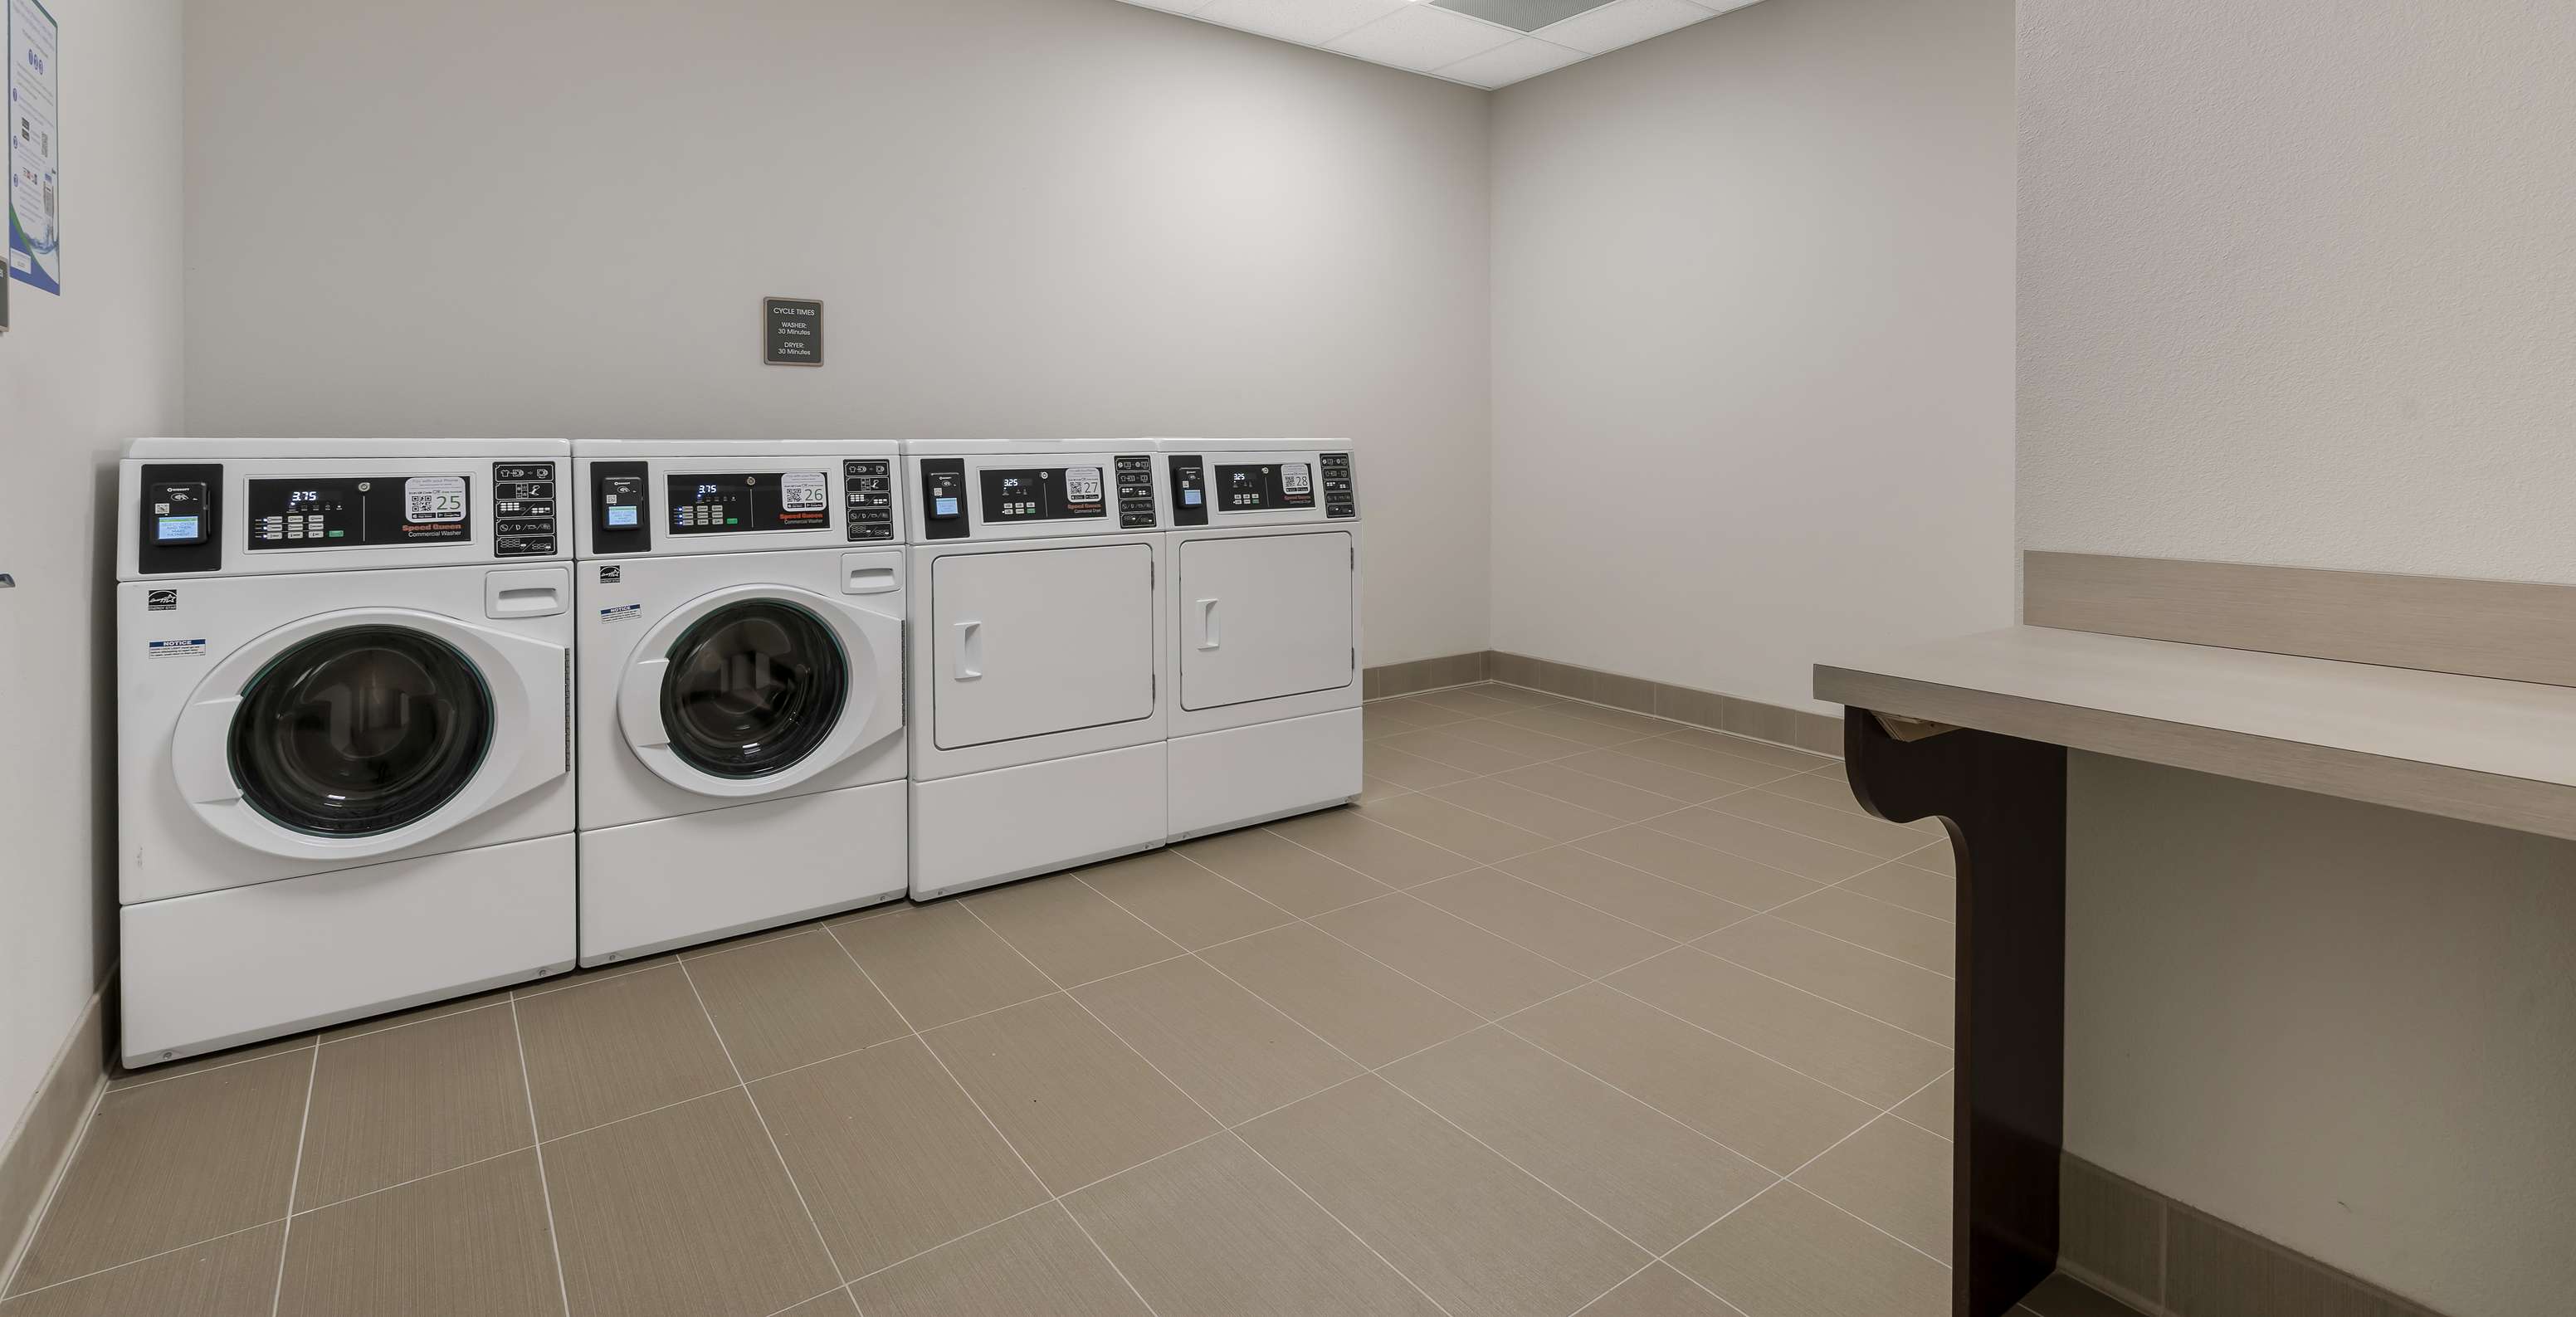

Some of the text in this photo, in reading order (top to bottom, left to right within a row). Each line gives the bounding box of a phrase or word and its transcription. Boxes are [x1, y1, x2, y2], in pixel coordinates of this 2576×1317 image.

[1295, 476, 1308, 486] 28
[699, 485, 717, 493] 3.75
[1084, 481, 1098, 494] 27
[292, 491, 317, 501] 3.75
[805, 488, 823, 501] 26
[437, 495, 461, 510] 25
[402, 524, 432, 532] Speed
